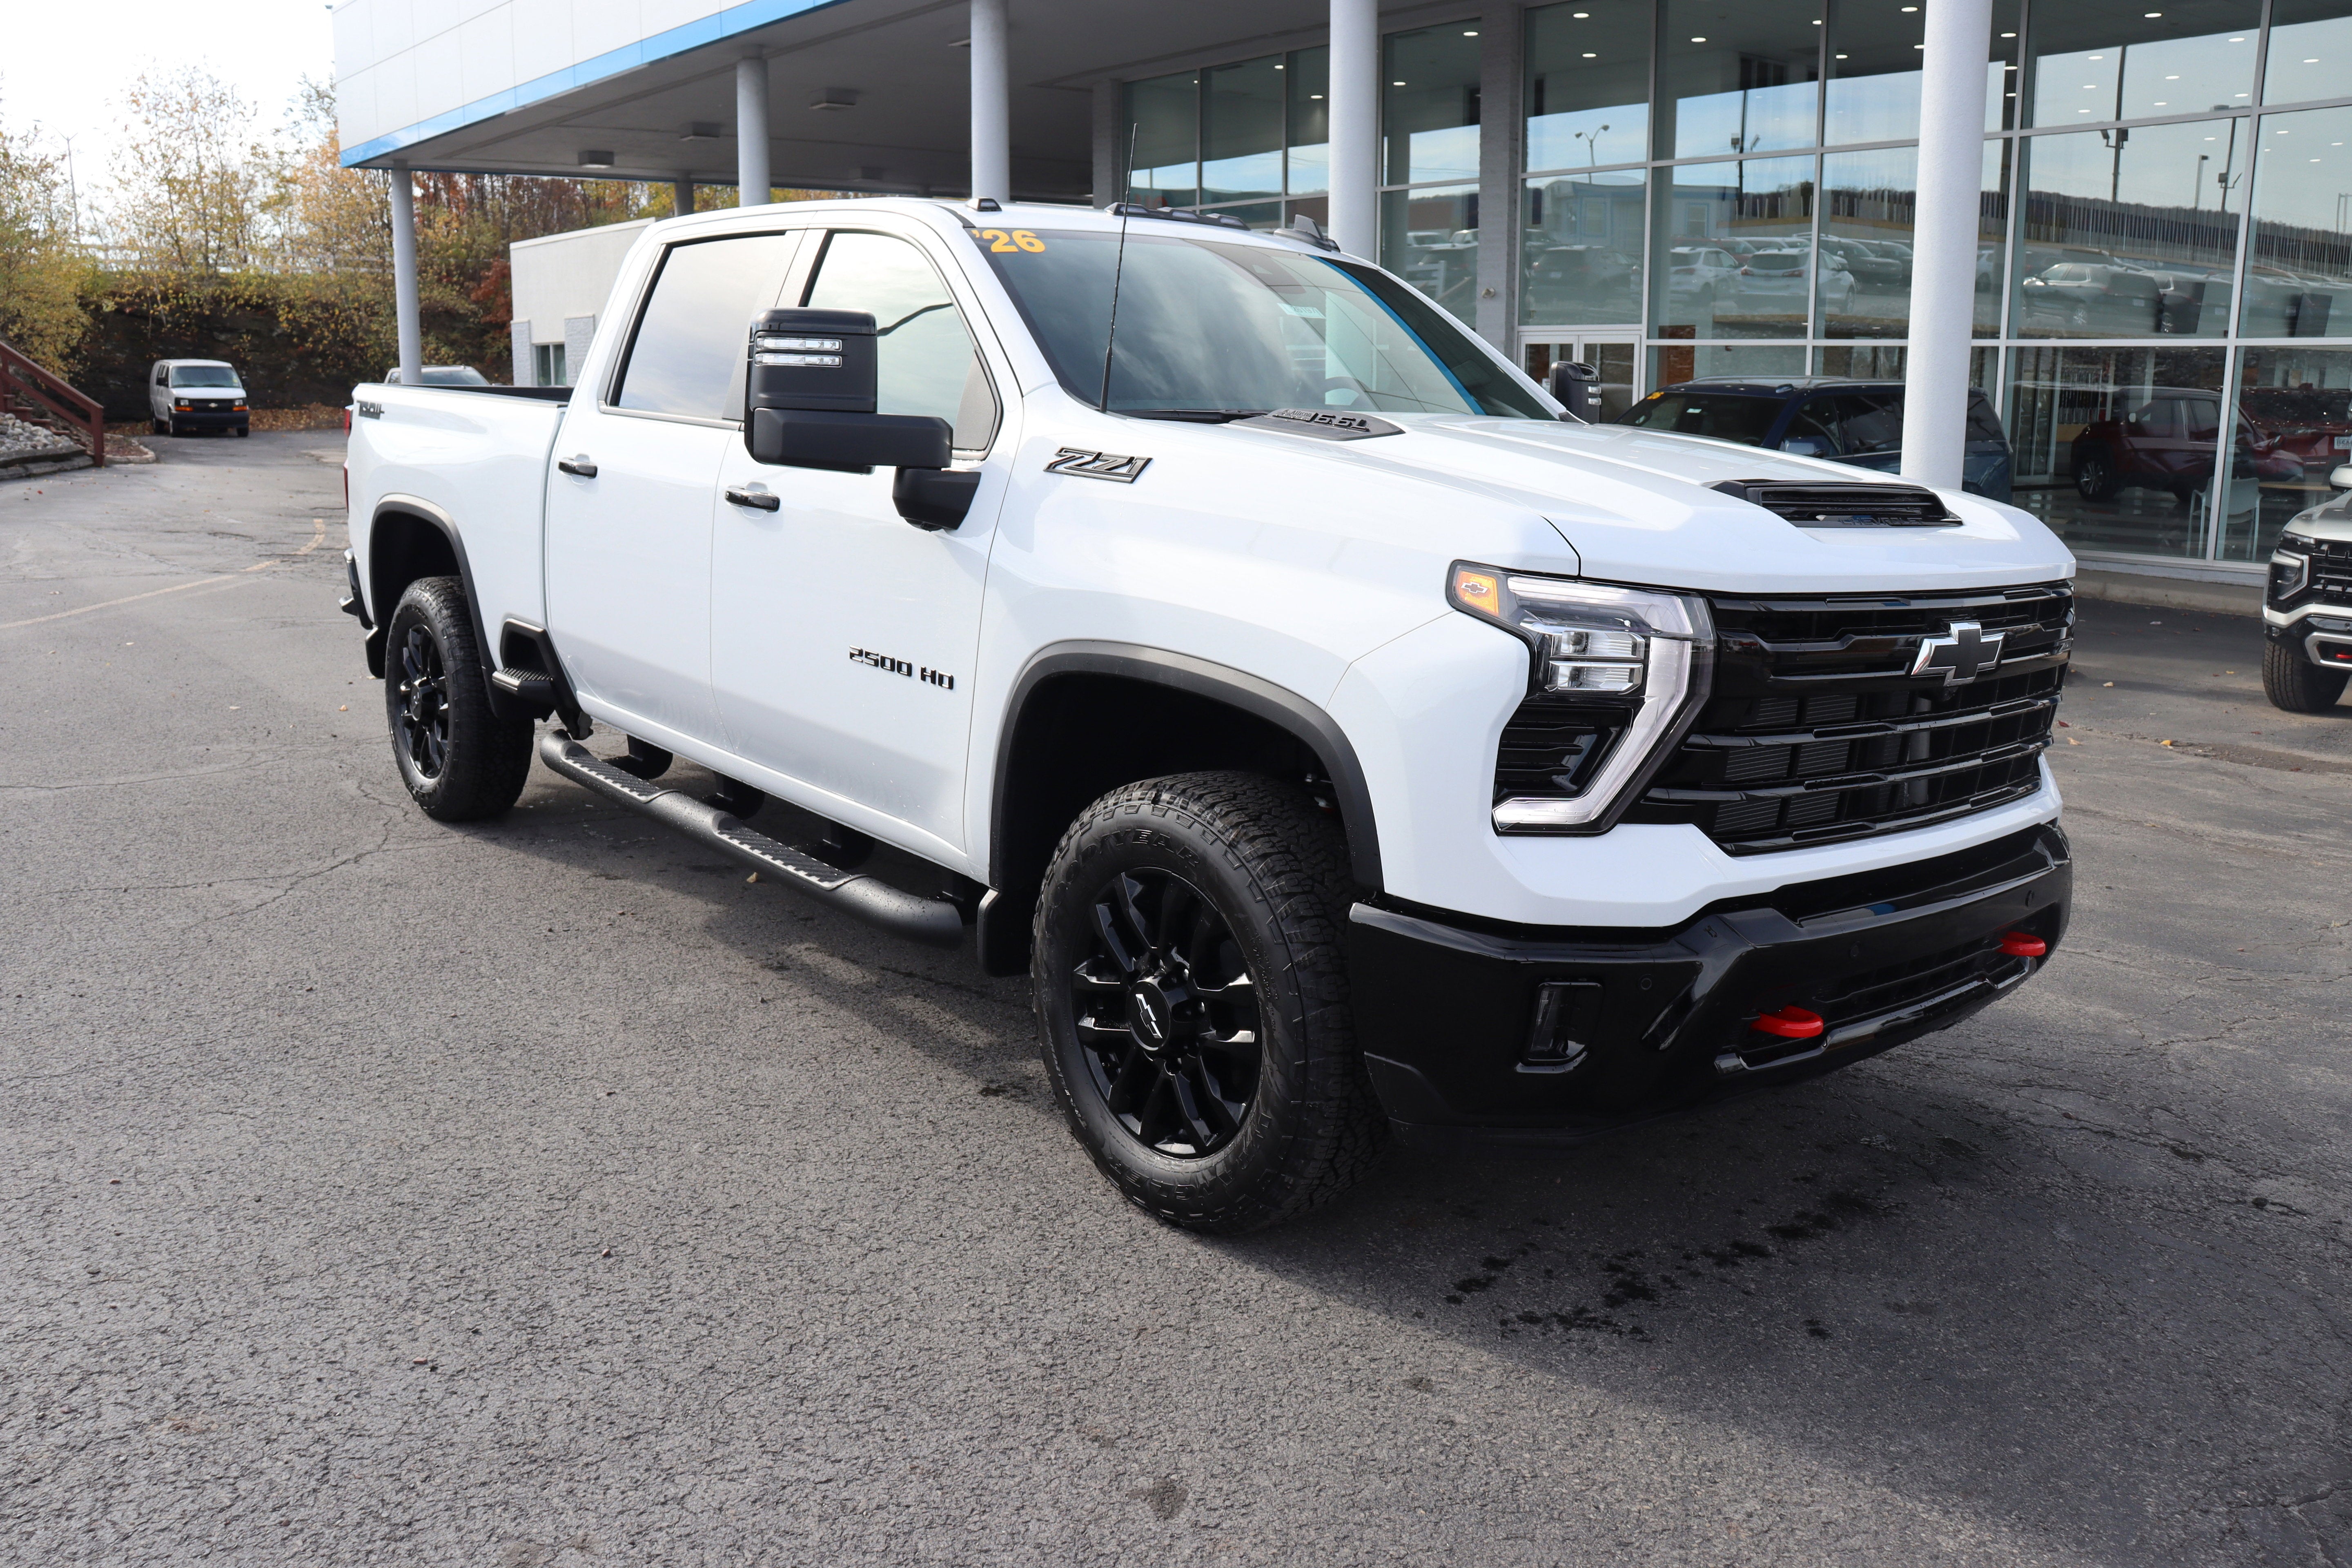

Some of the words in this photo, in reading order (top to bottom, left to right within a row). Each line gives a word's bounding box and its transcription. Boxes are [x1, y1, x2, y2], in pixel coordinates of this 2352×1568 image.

[1042, 445, 1154, 484] Z71
[1838, 517, 1923, 526] CHEVROLET
[849, 644, 912, 677] 2500
[920, 666, 954, 690] HD
